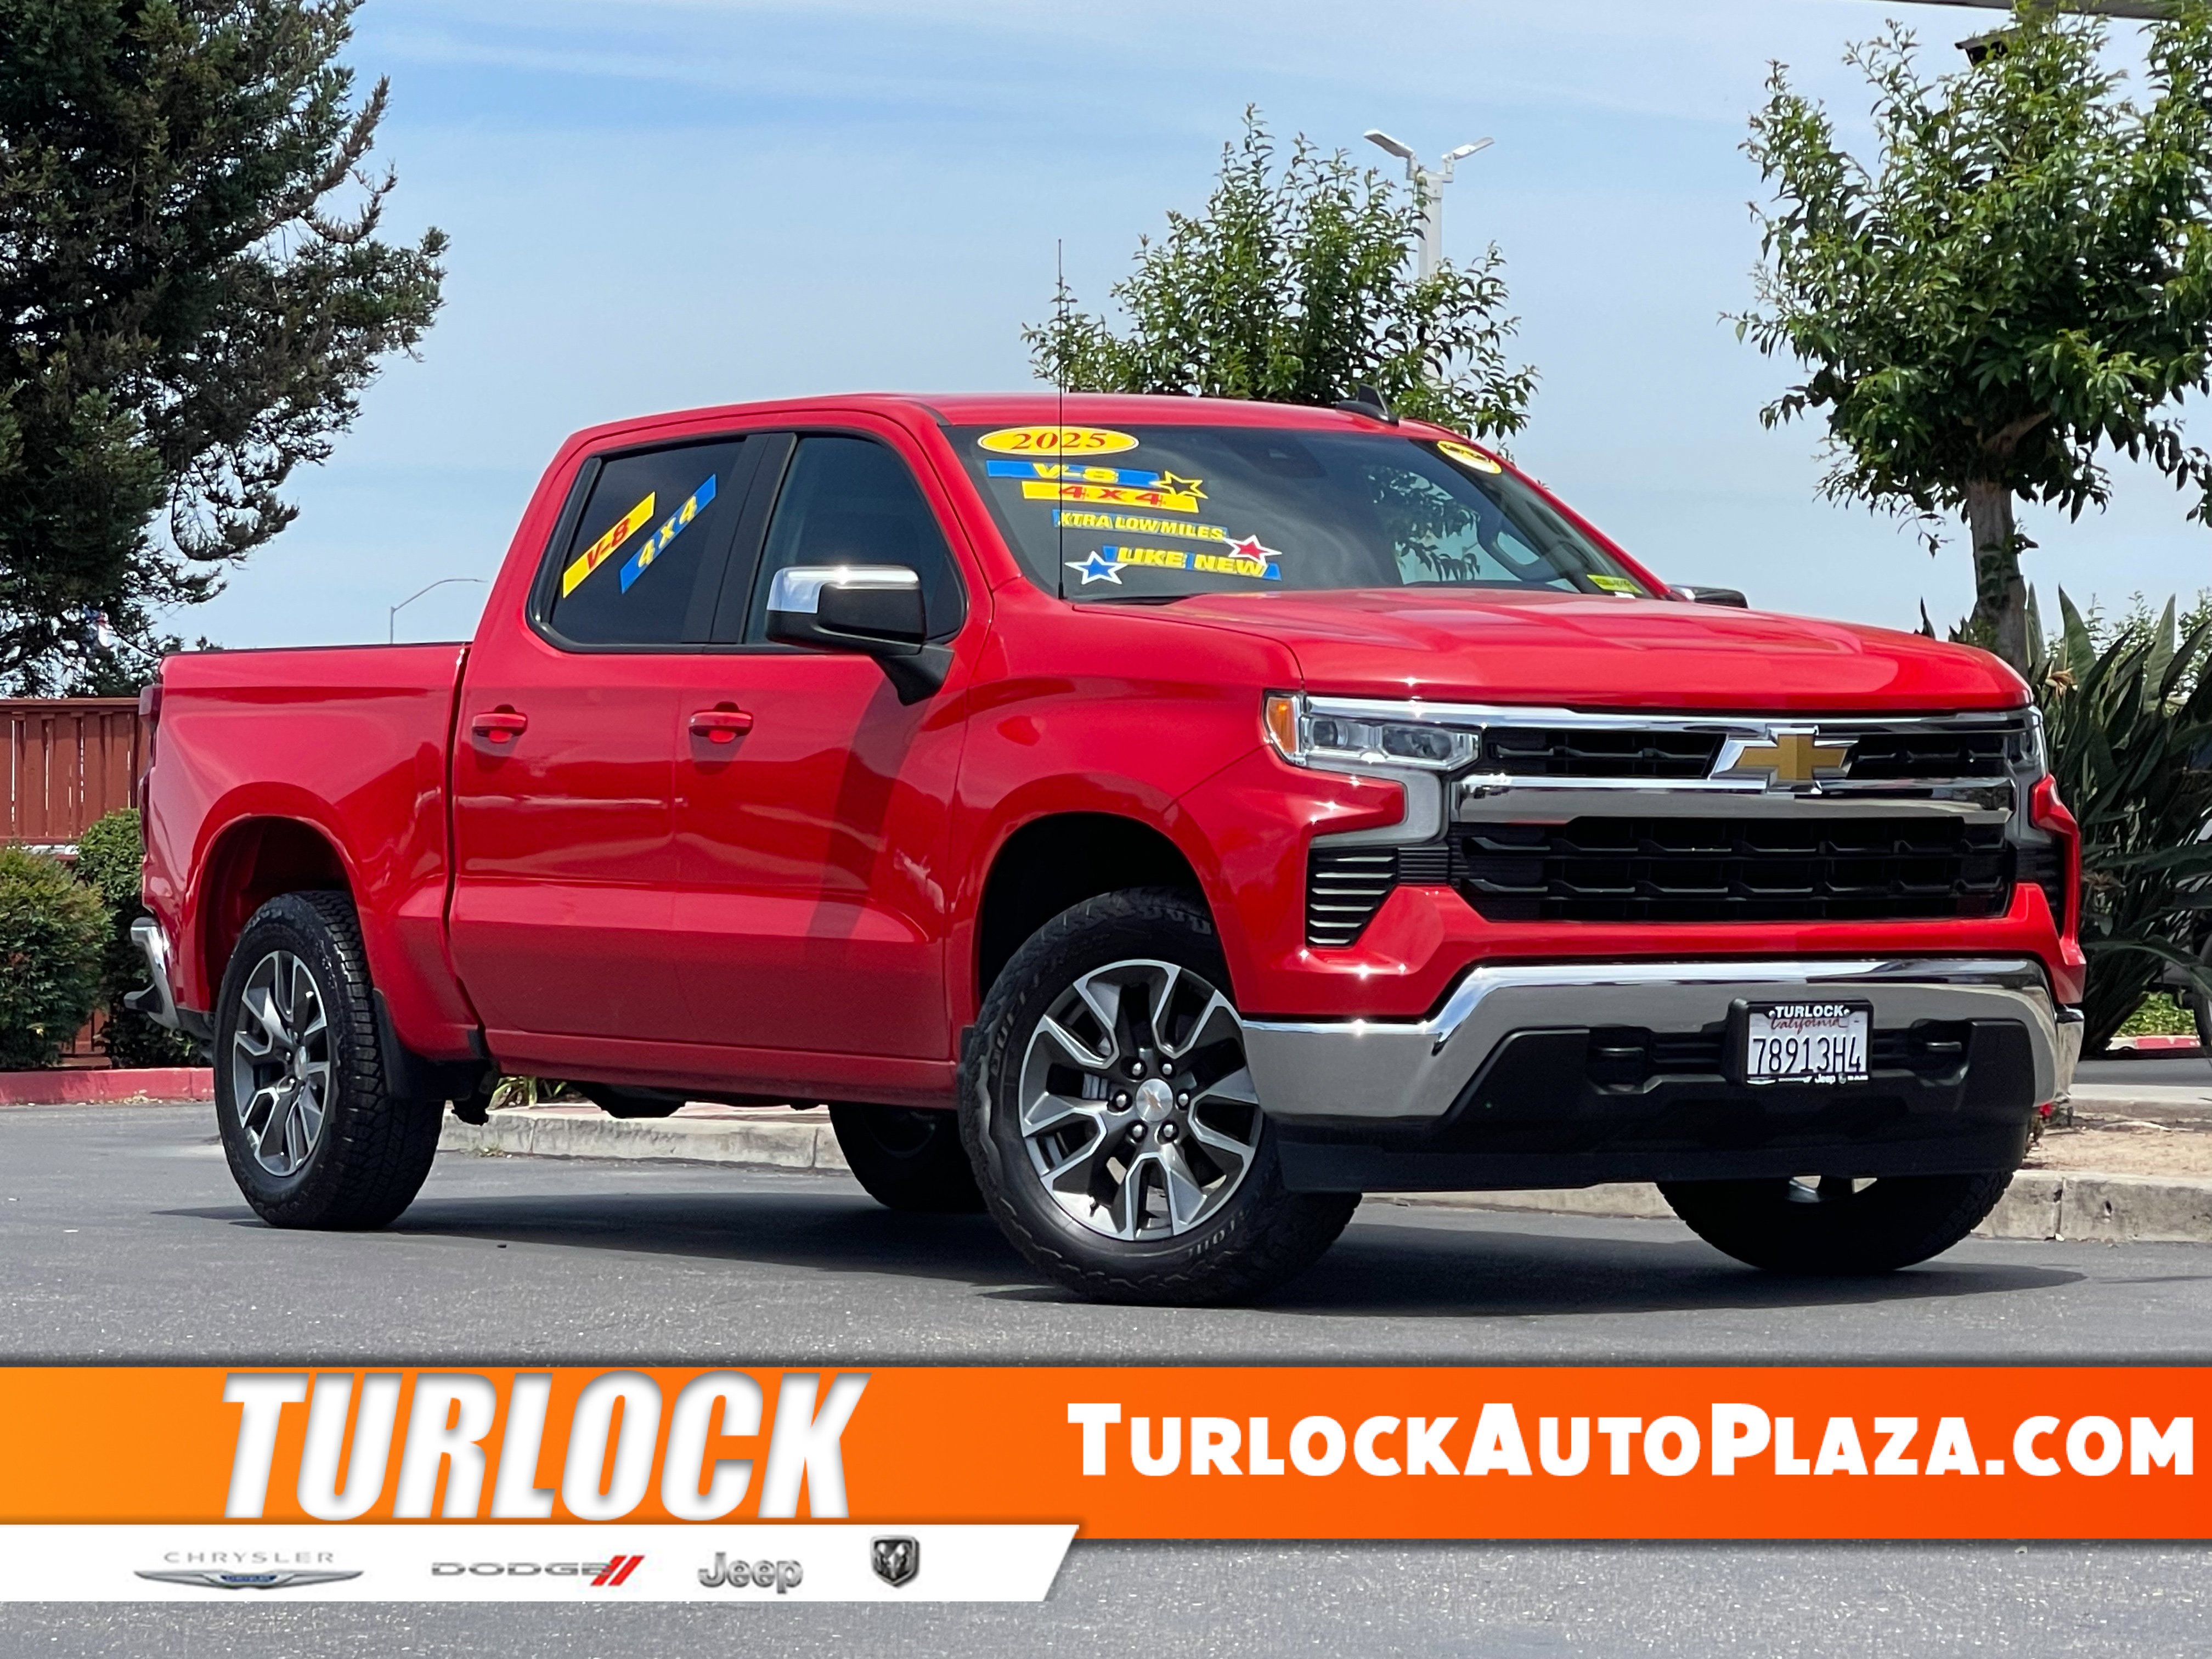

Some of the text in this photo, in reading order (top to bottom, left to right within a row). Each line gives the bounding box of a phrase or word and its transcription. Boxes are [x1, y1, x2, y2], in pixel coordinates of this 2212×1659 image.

[1011, 433, 1107, 450] 2025
[1033, 463, 1119, 483] V-8
[587, 518, 631, 570] V-8
[1118, 548, 1267, 577] LIKE NEW
[1775, 1005, 1844, 1018] TURLOCK
[1771, 1017, 1849, 1035] California
[1753, 1036, 1861, 1074] 78913H4
